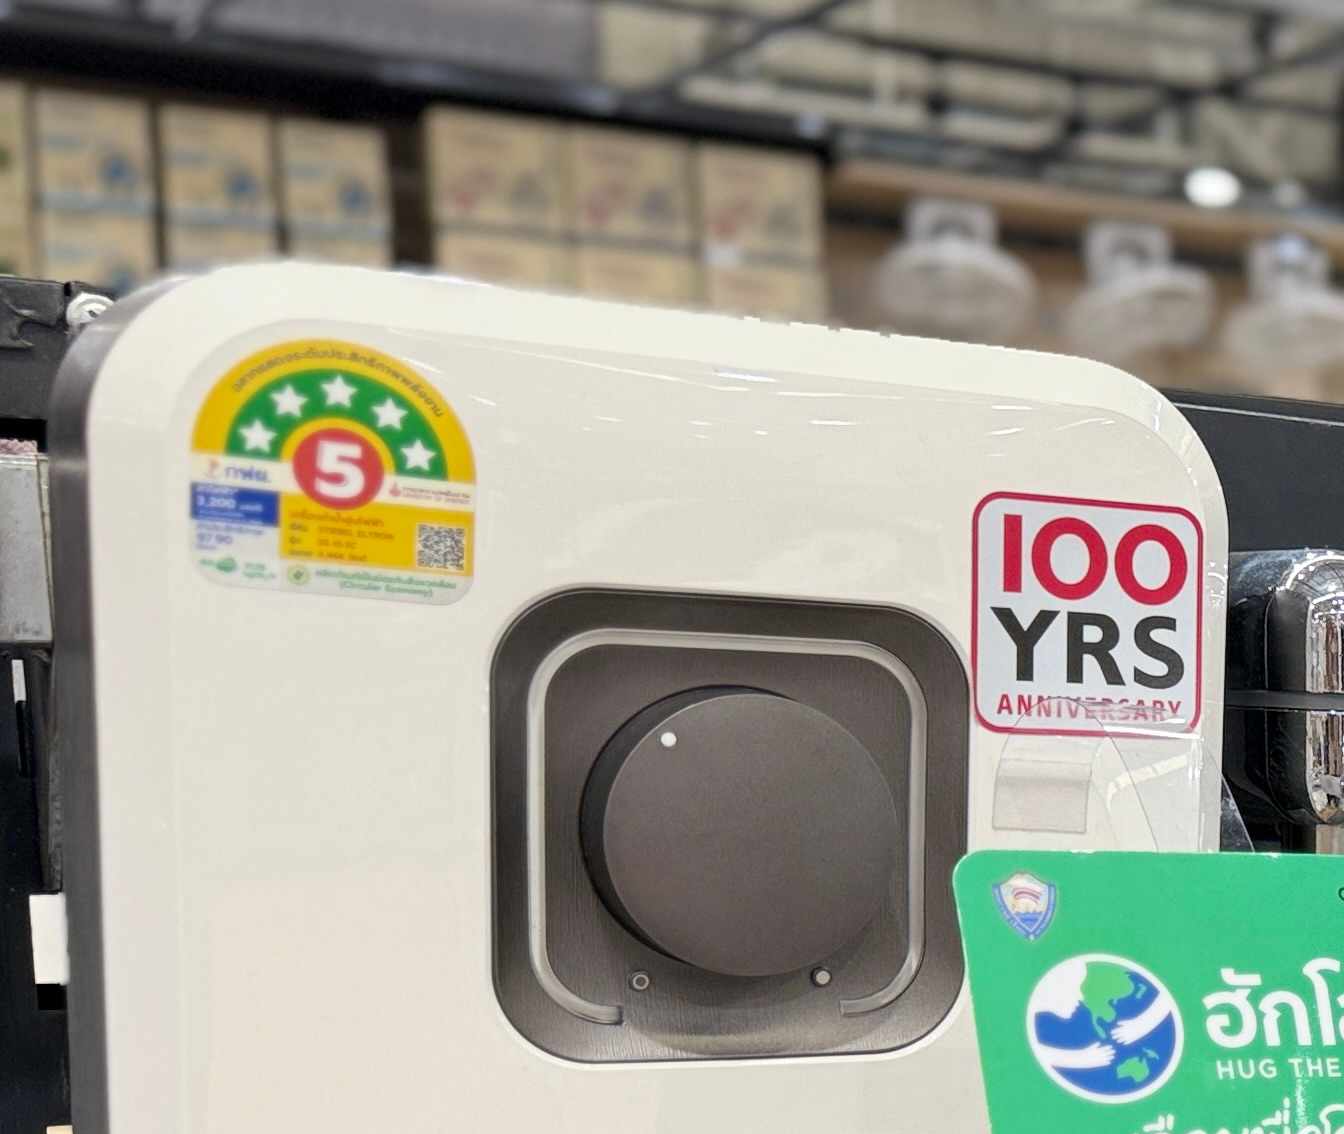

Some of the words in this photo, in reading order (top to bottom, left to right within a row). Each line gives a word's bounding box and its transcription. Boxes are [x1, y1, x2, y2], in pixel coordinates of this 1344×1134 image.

[314, 440, 366, 500] 5
[990, 606, 1185, 690] YRS
[996, 693, 1182, 722] ANNIVERSARY
[1216, 1058, 1277, 1080] HUG
[1288, 1057, 1342, 1079] THE
